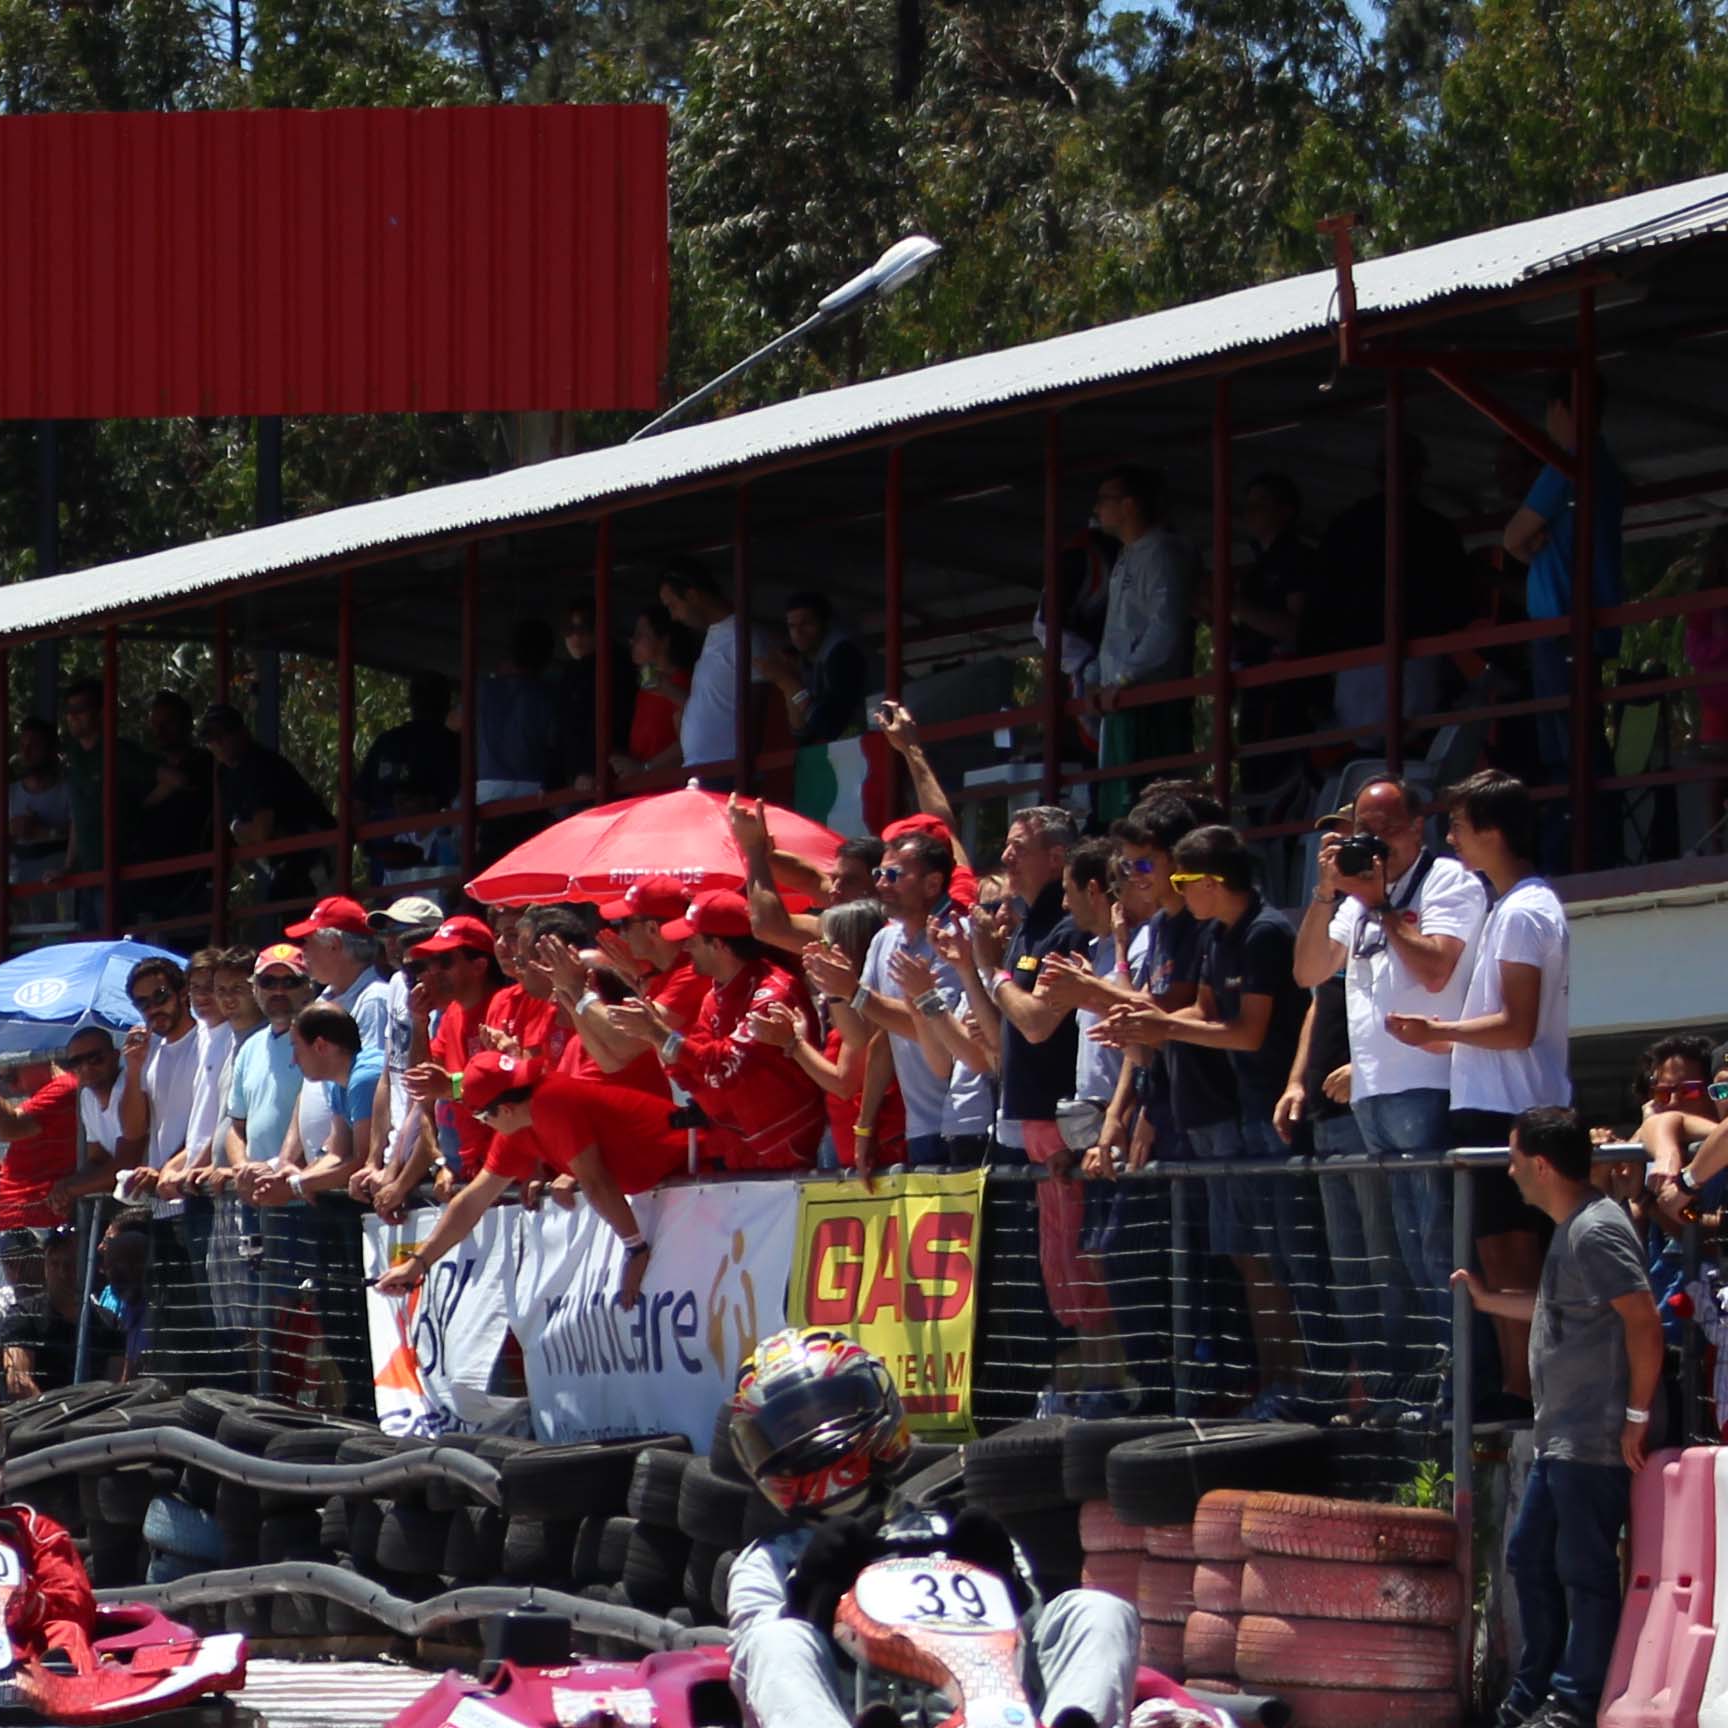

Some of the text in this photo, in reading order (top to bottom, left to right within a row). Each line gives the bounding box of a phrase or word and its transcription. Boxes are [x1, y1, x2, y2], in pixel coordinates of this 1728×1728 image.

[608, 866, 705, 885] FIDEADE
[804, 1211, 975, 1326] GAS
[542, 1267, 704, 1377] multicare
[911, 1573, 987, 1618] 39
